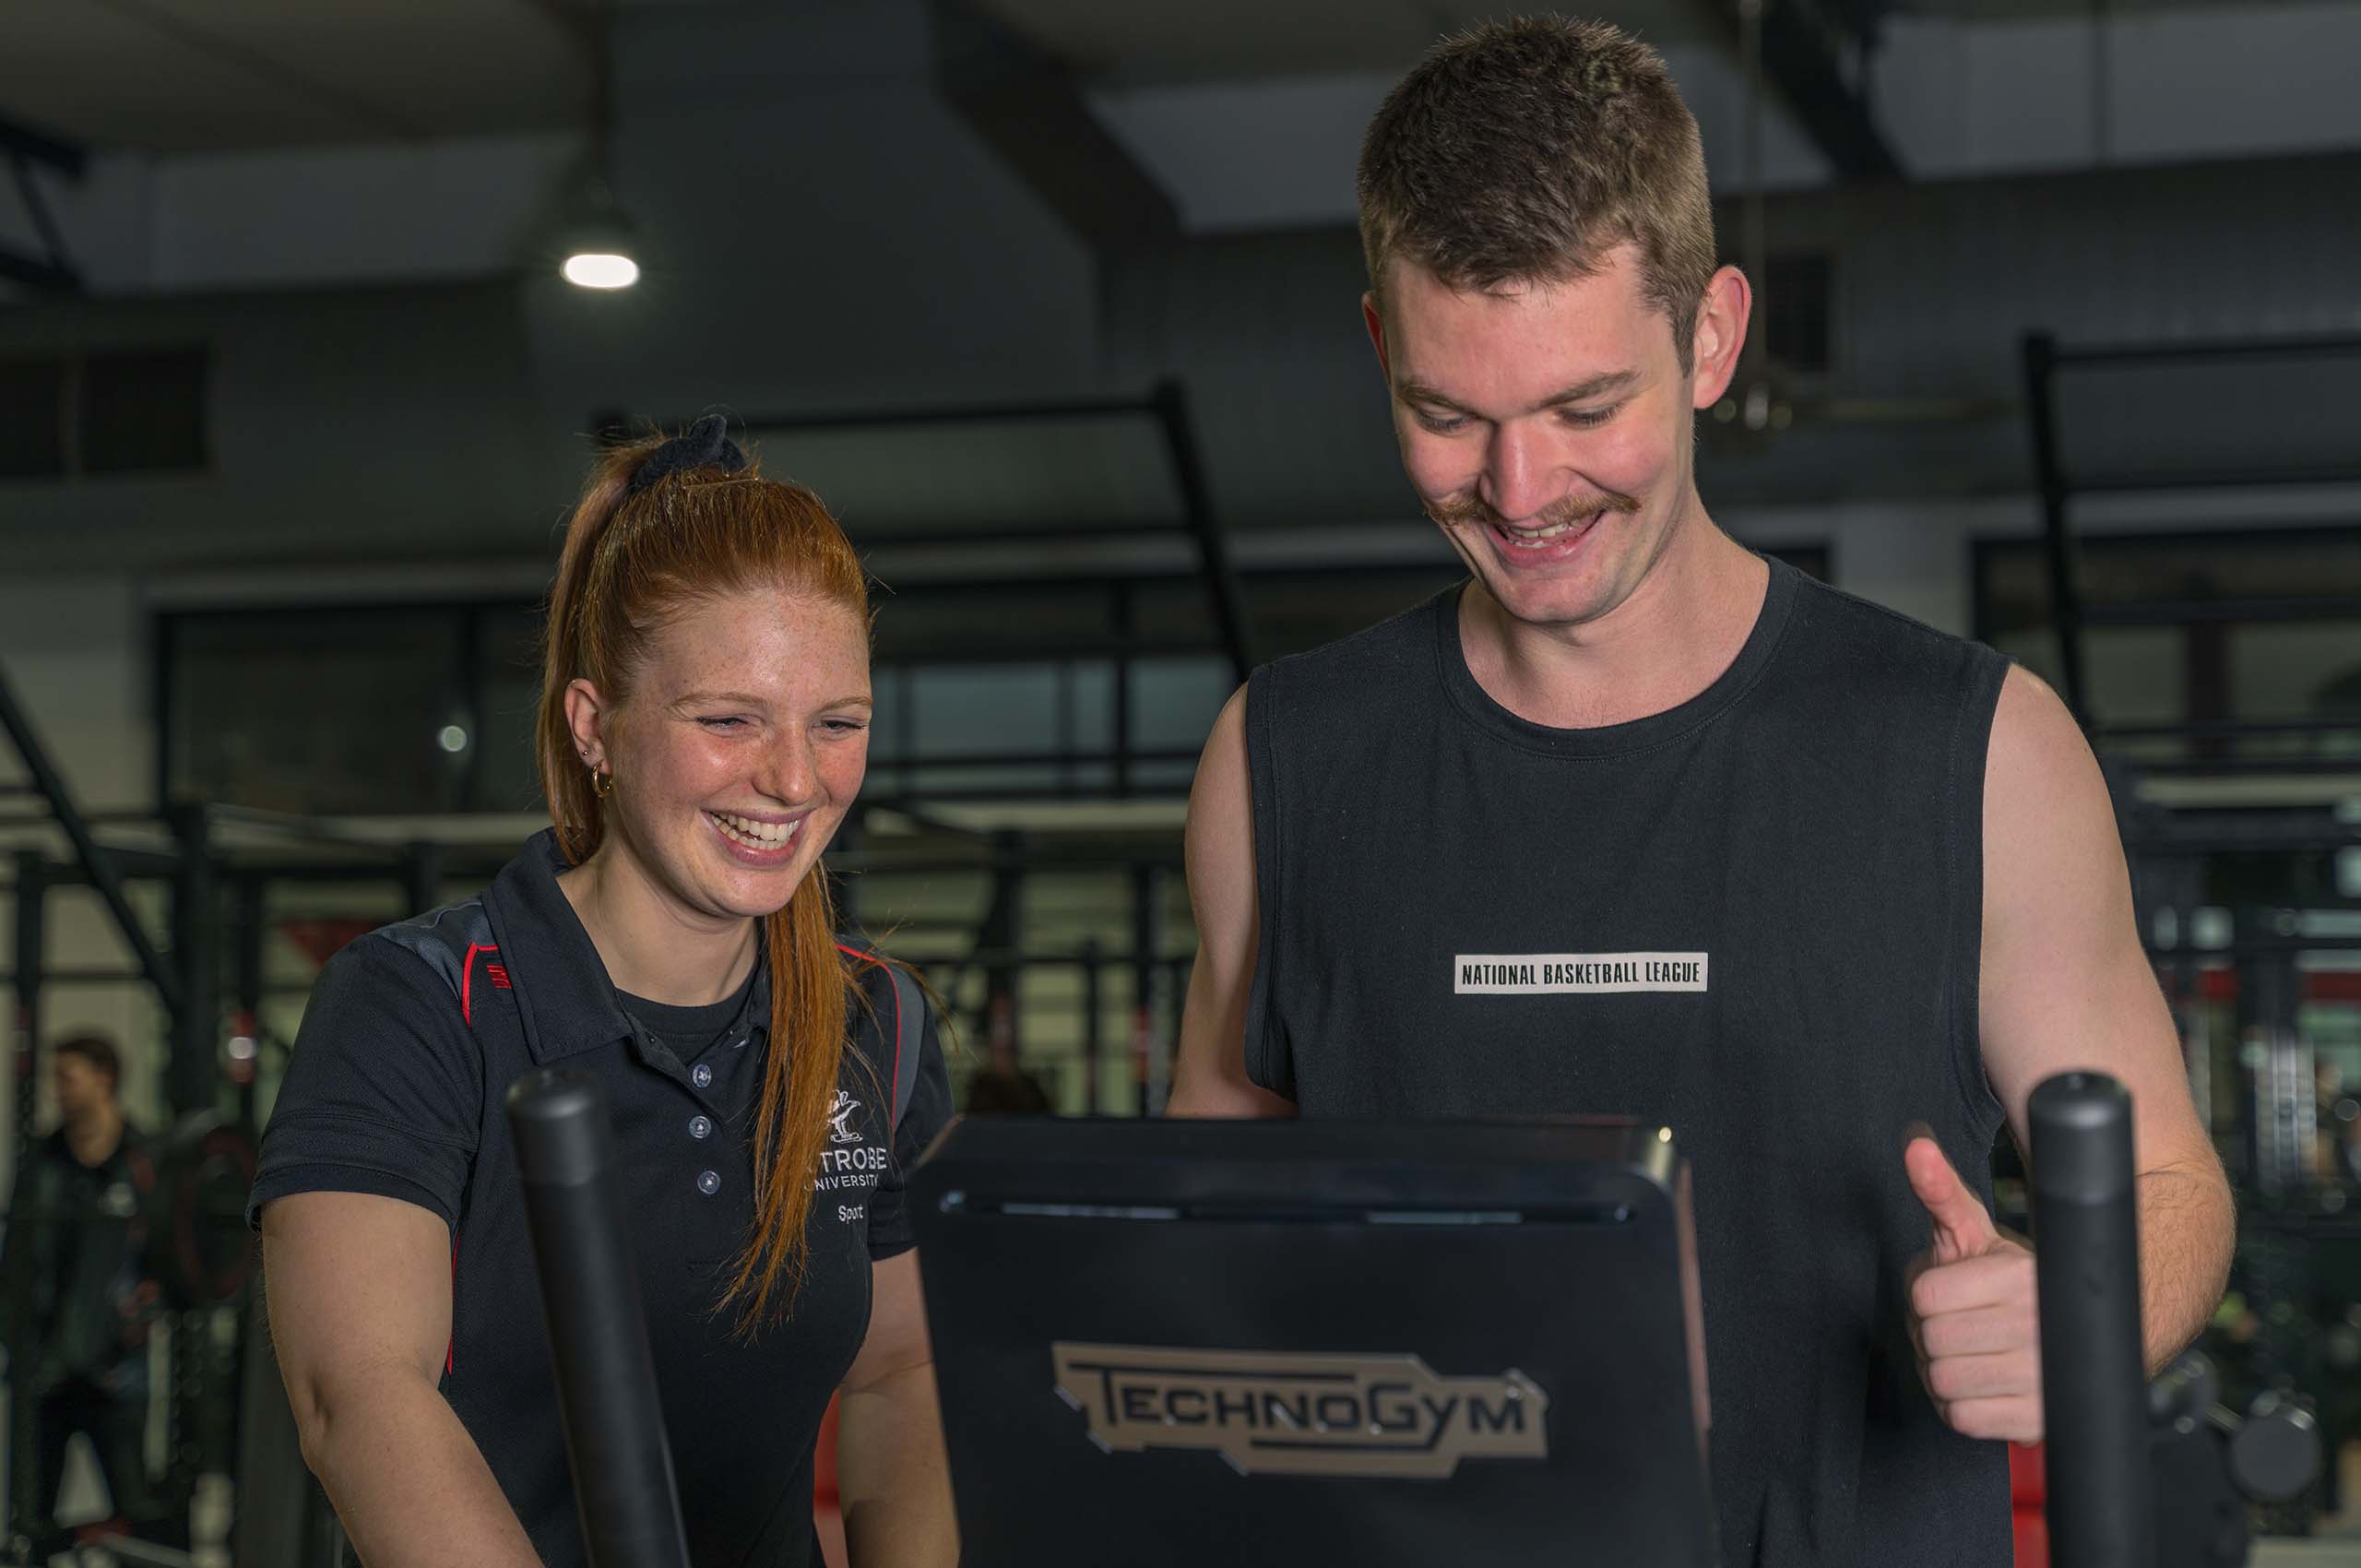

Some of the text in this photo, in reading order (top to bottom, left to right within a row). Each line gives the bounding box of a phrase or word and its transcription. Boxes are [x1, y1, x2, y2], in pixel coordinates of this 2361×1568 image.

[1462, 961, 1700, 985] NATIONAL BASKETBALL LEAGUE
[837, 1203, 864, 1225] Sport
